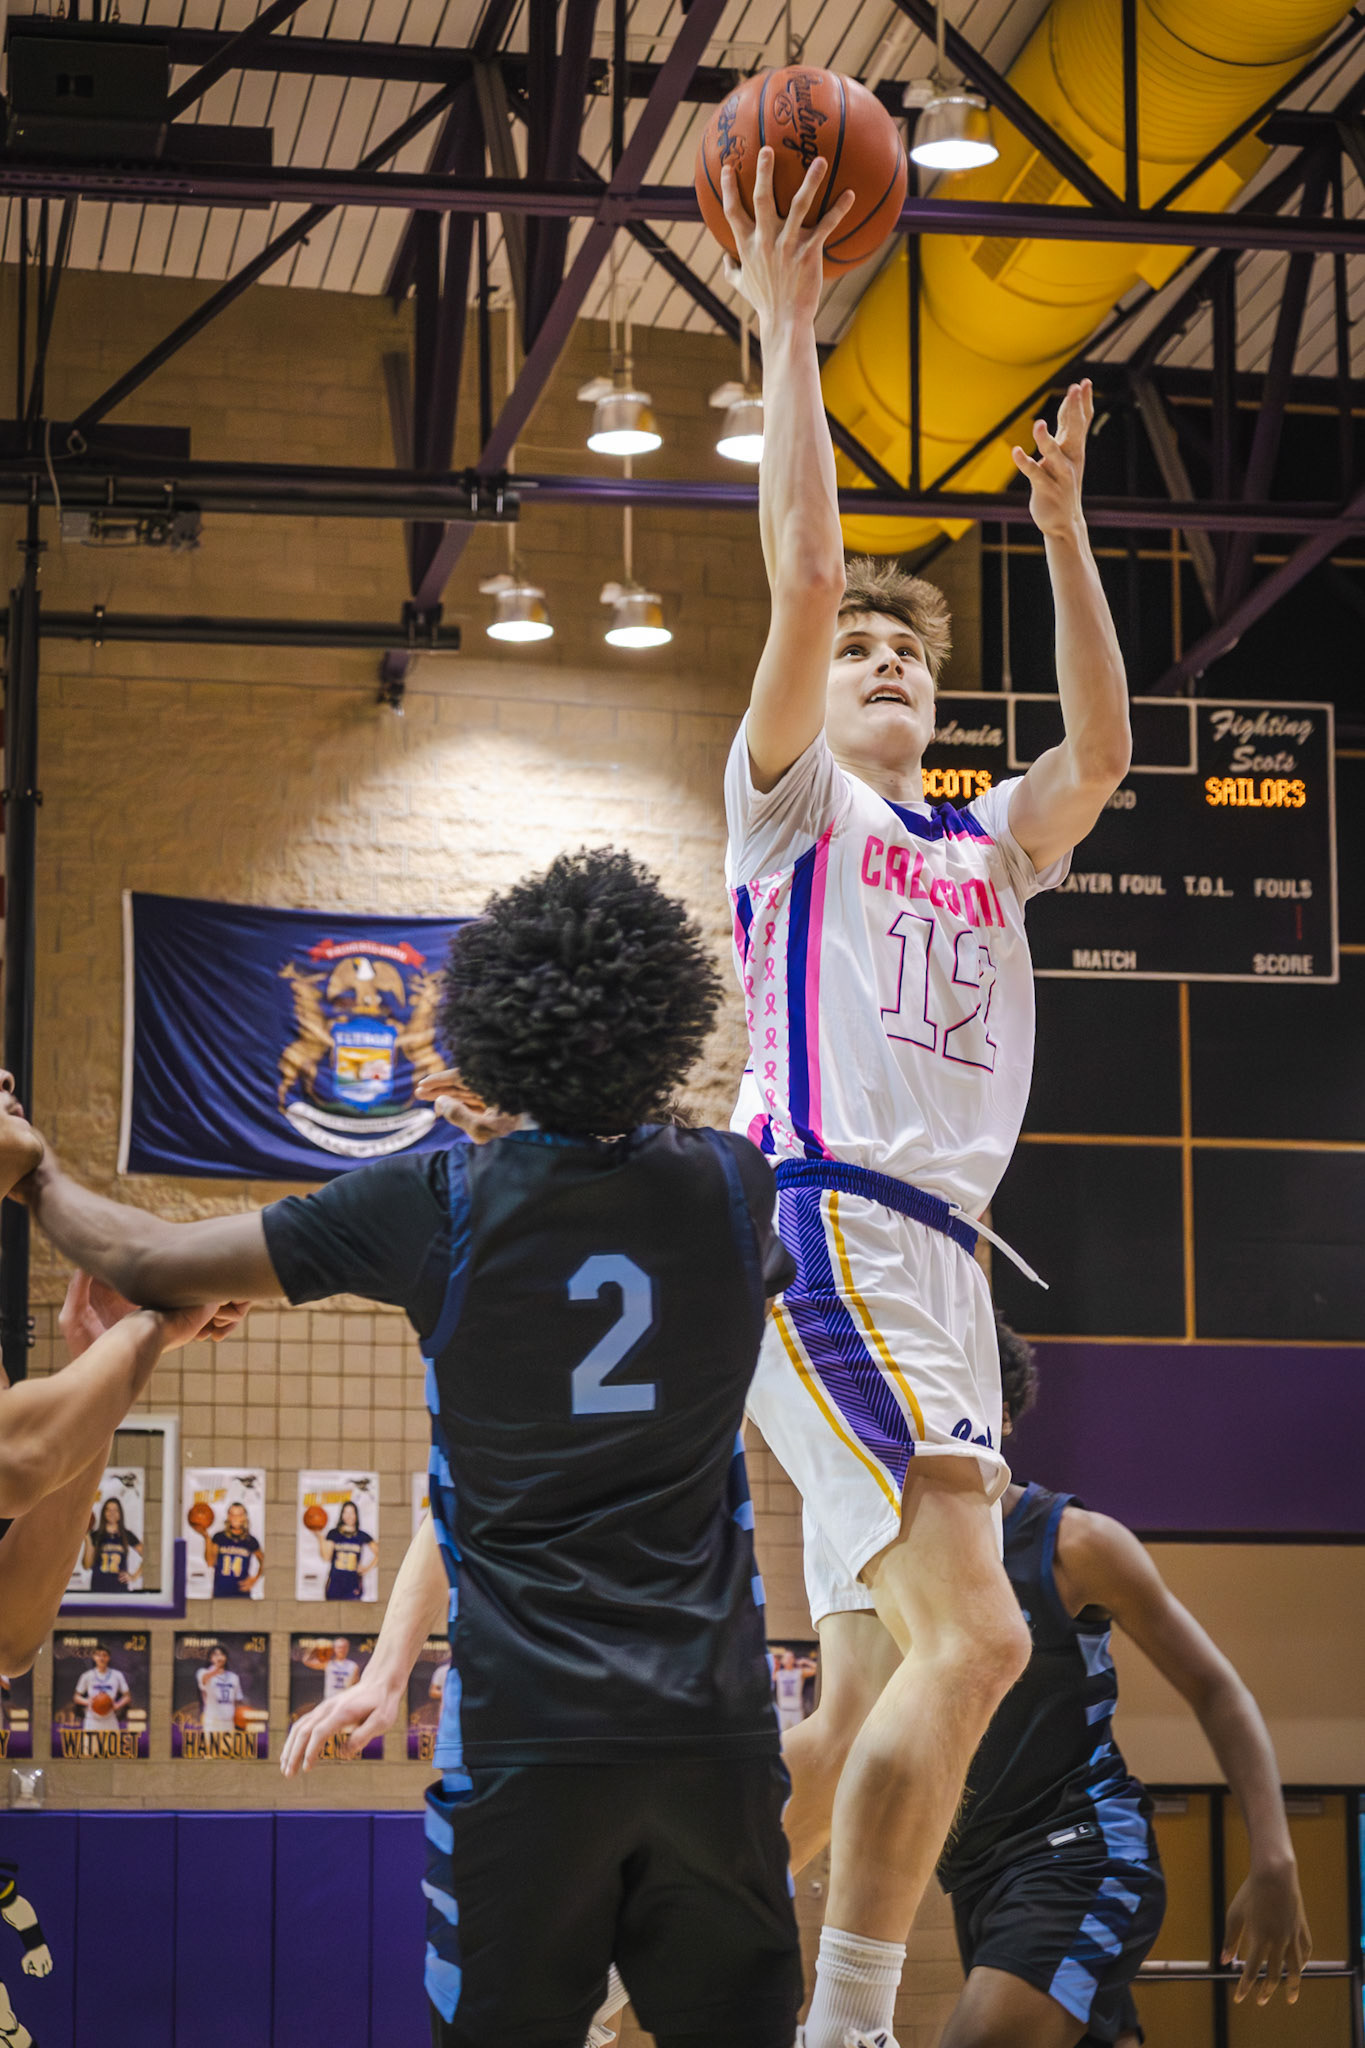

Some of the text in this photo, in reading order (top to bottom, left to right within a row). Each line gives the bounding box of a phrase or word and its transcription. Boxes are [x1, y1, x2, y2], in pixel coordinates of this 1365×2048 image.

[1210, 709, 1314, 745] Fighting
[1229, 745, 1297, 772] Scots
[1205, 776, 1306, 808] SAILORS
[1119, 874, 1167, 895] FOUL
[1254, 878, 1313, 899] FOULS
[1072, 949, 1137, 970] MATCH
[1253, 953, 1314, 975] SCORE
[567, 1253, 657, 1415] 2
[59, 1728, 139, 1759] WITVOET
[183, 1729, 258, 1759] HANSON
